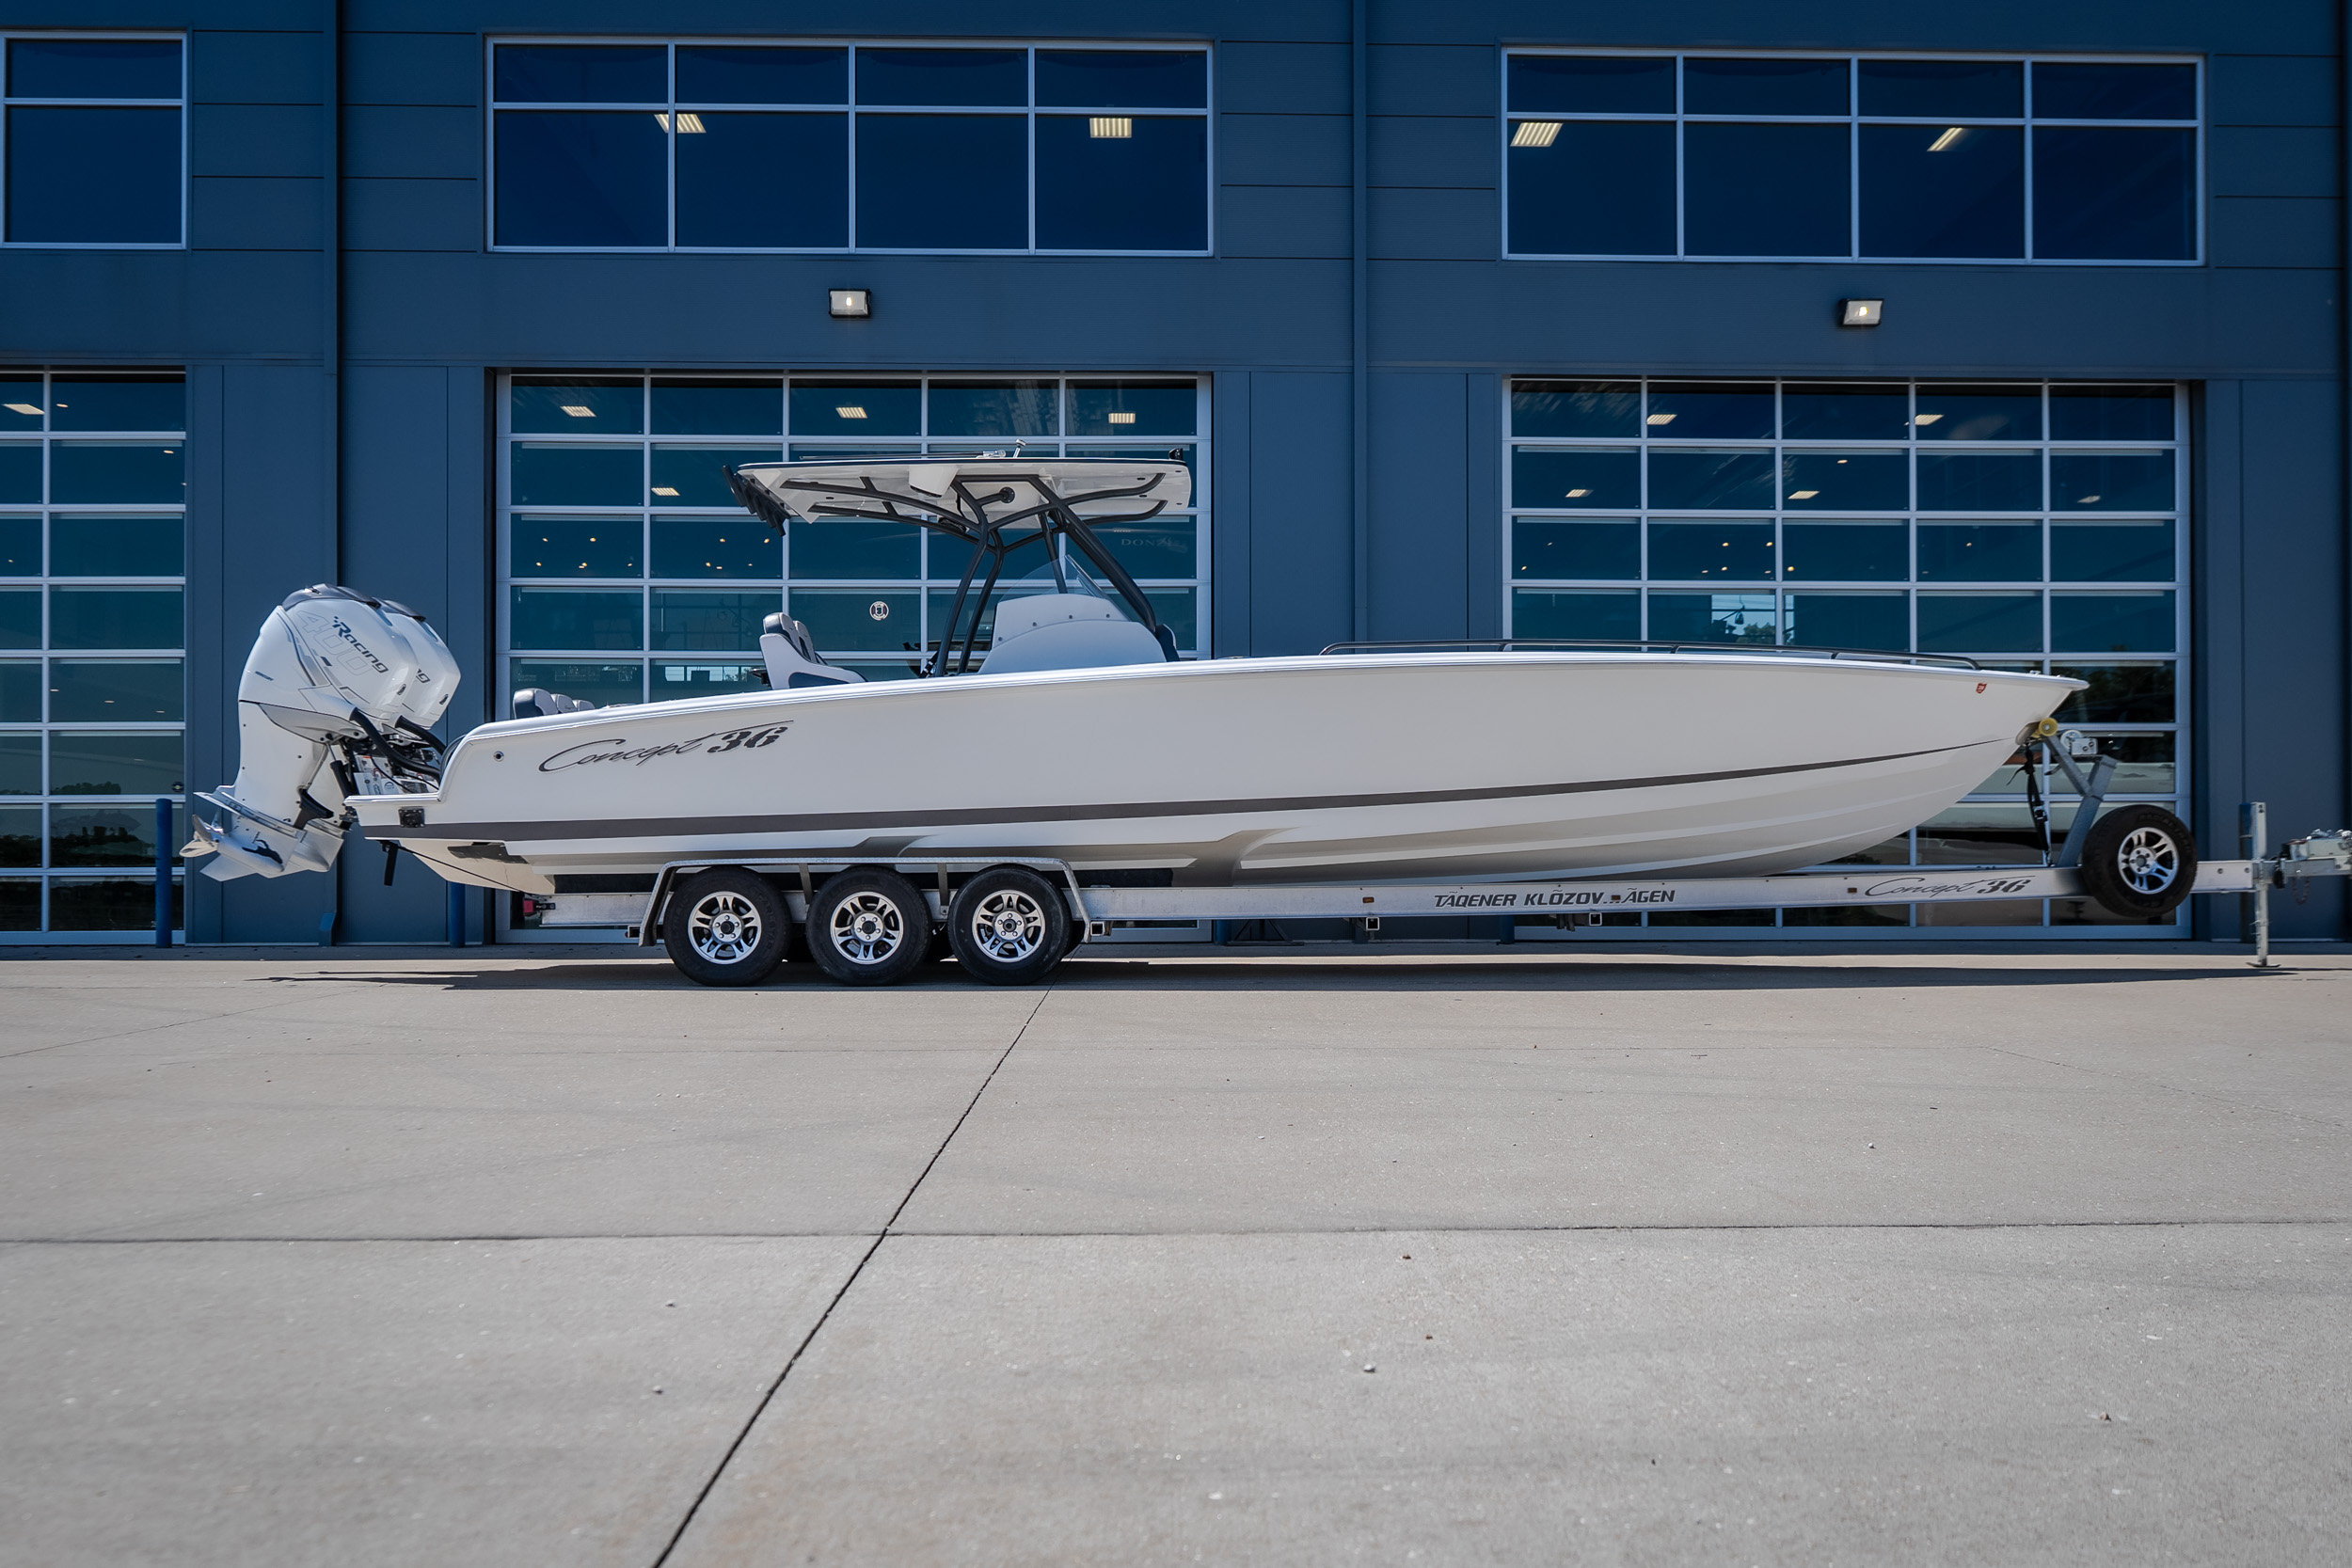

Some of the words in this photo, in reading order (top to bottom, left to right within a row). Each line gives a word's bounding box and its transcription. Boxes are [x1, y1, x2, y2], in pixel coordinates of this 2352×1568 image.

[295, 610, 373, 676] 400
[332, 616, 389, 673] Racing
[539, 730, 726, 772] Concept
[707, 726, 788, 753] 36
[1865, 878, 1987, 898] Concept
[1977, 879, 2032, 894] 36
